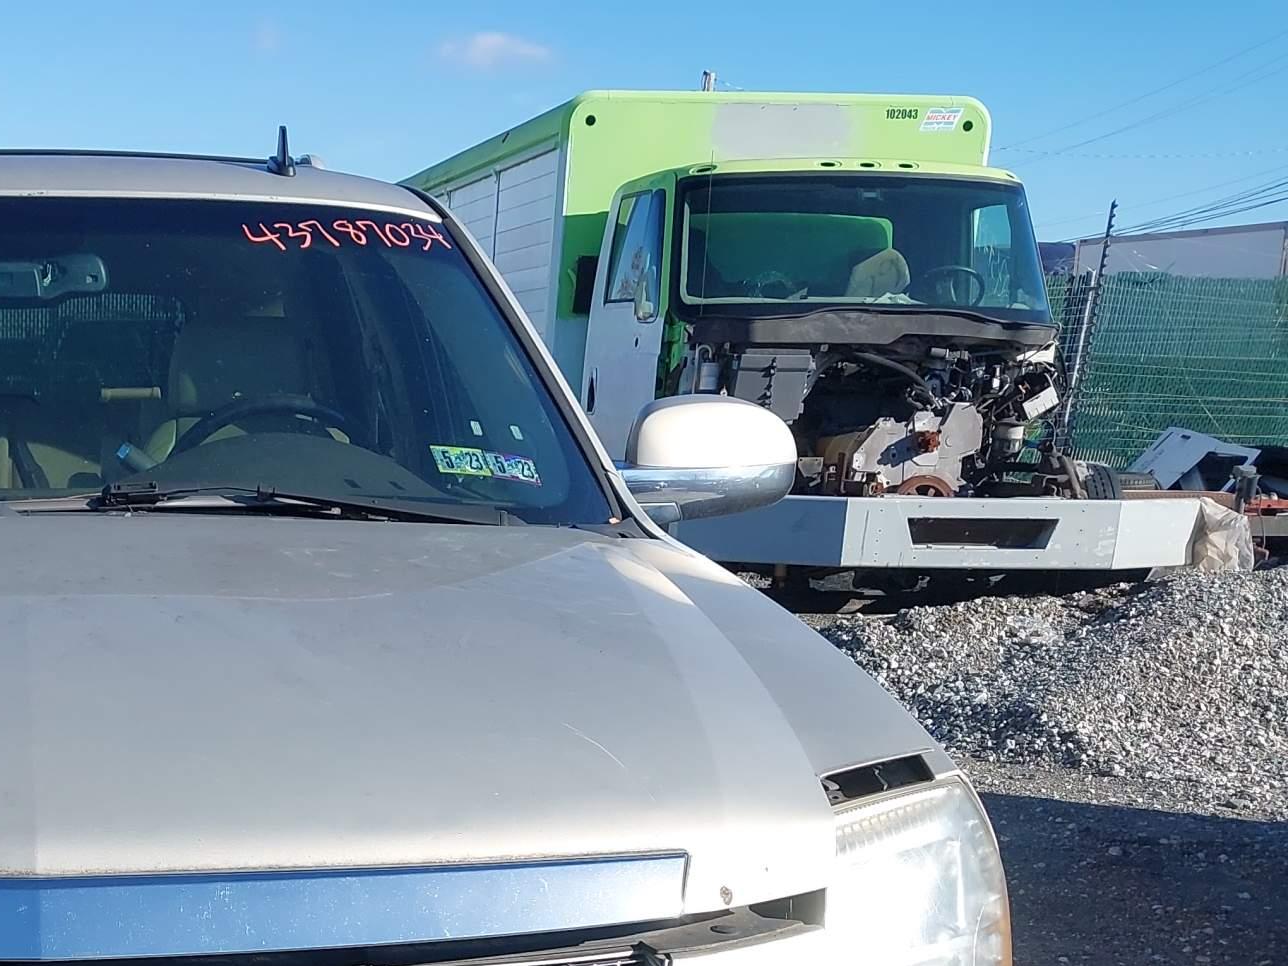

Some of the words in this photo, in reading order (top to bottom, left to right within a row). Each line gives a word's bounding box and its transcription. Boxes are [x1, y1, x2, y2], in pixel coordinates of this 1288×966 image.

[885, 108, 919, 120] 102043
[241, 220, 452, 251] 43787034
[441, 450, 454, 469] 5
[465, 452, 484, 471] 23
[494, 455, 506, 474] 5
[517, 460, 535, 479] 23
